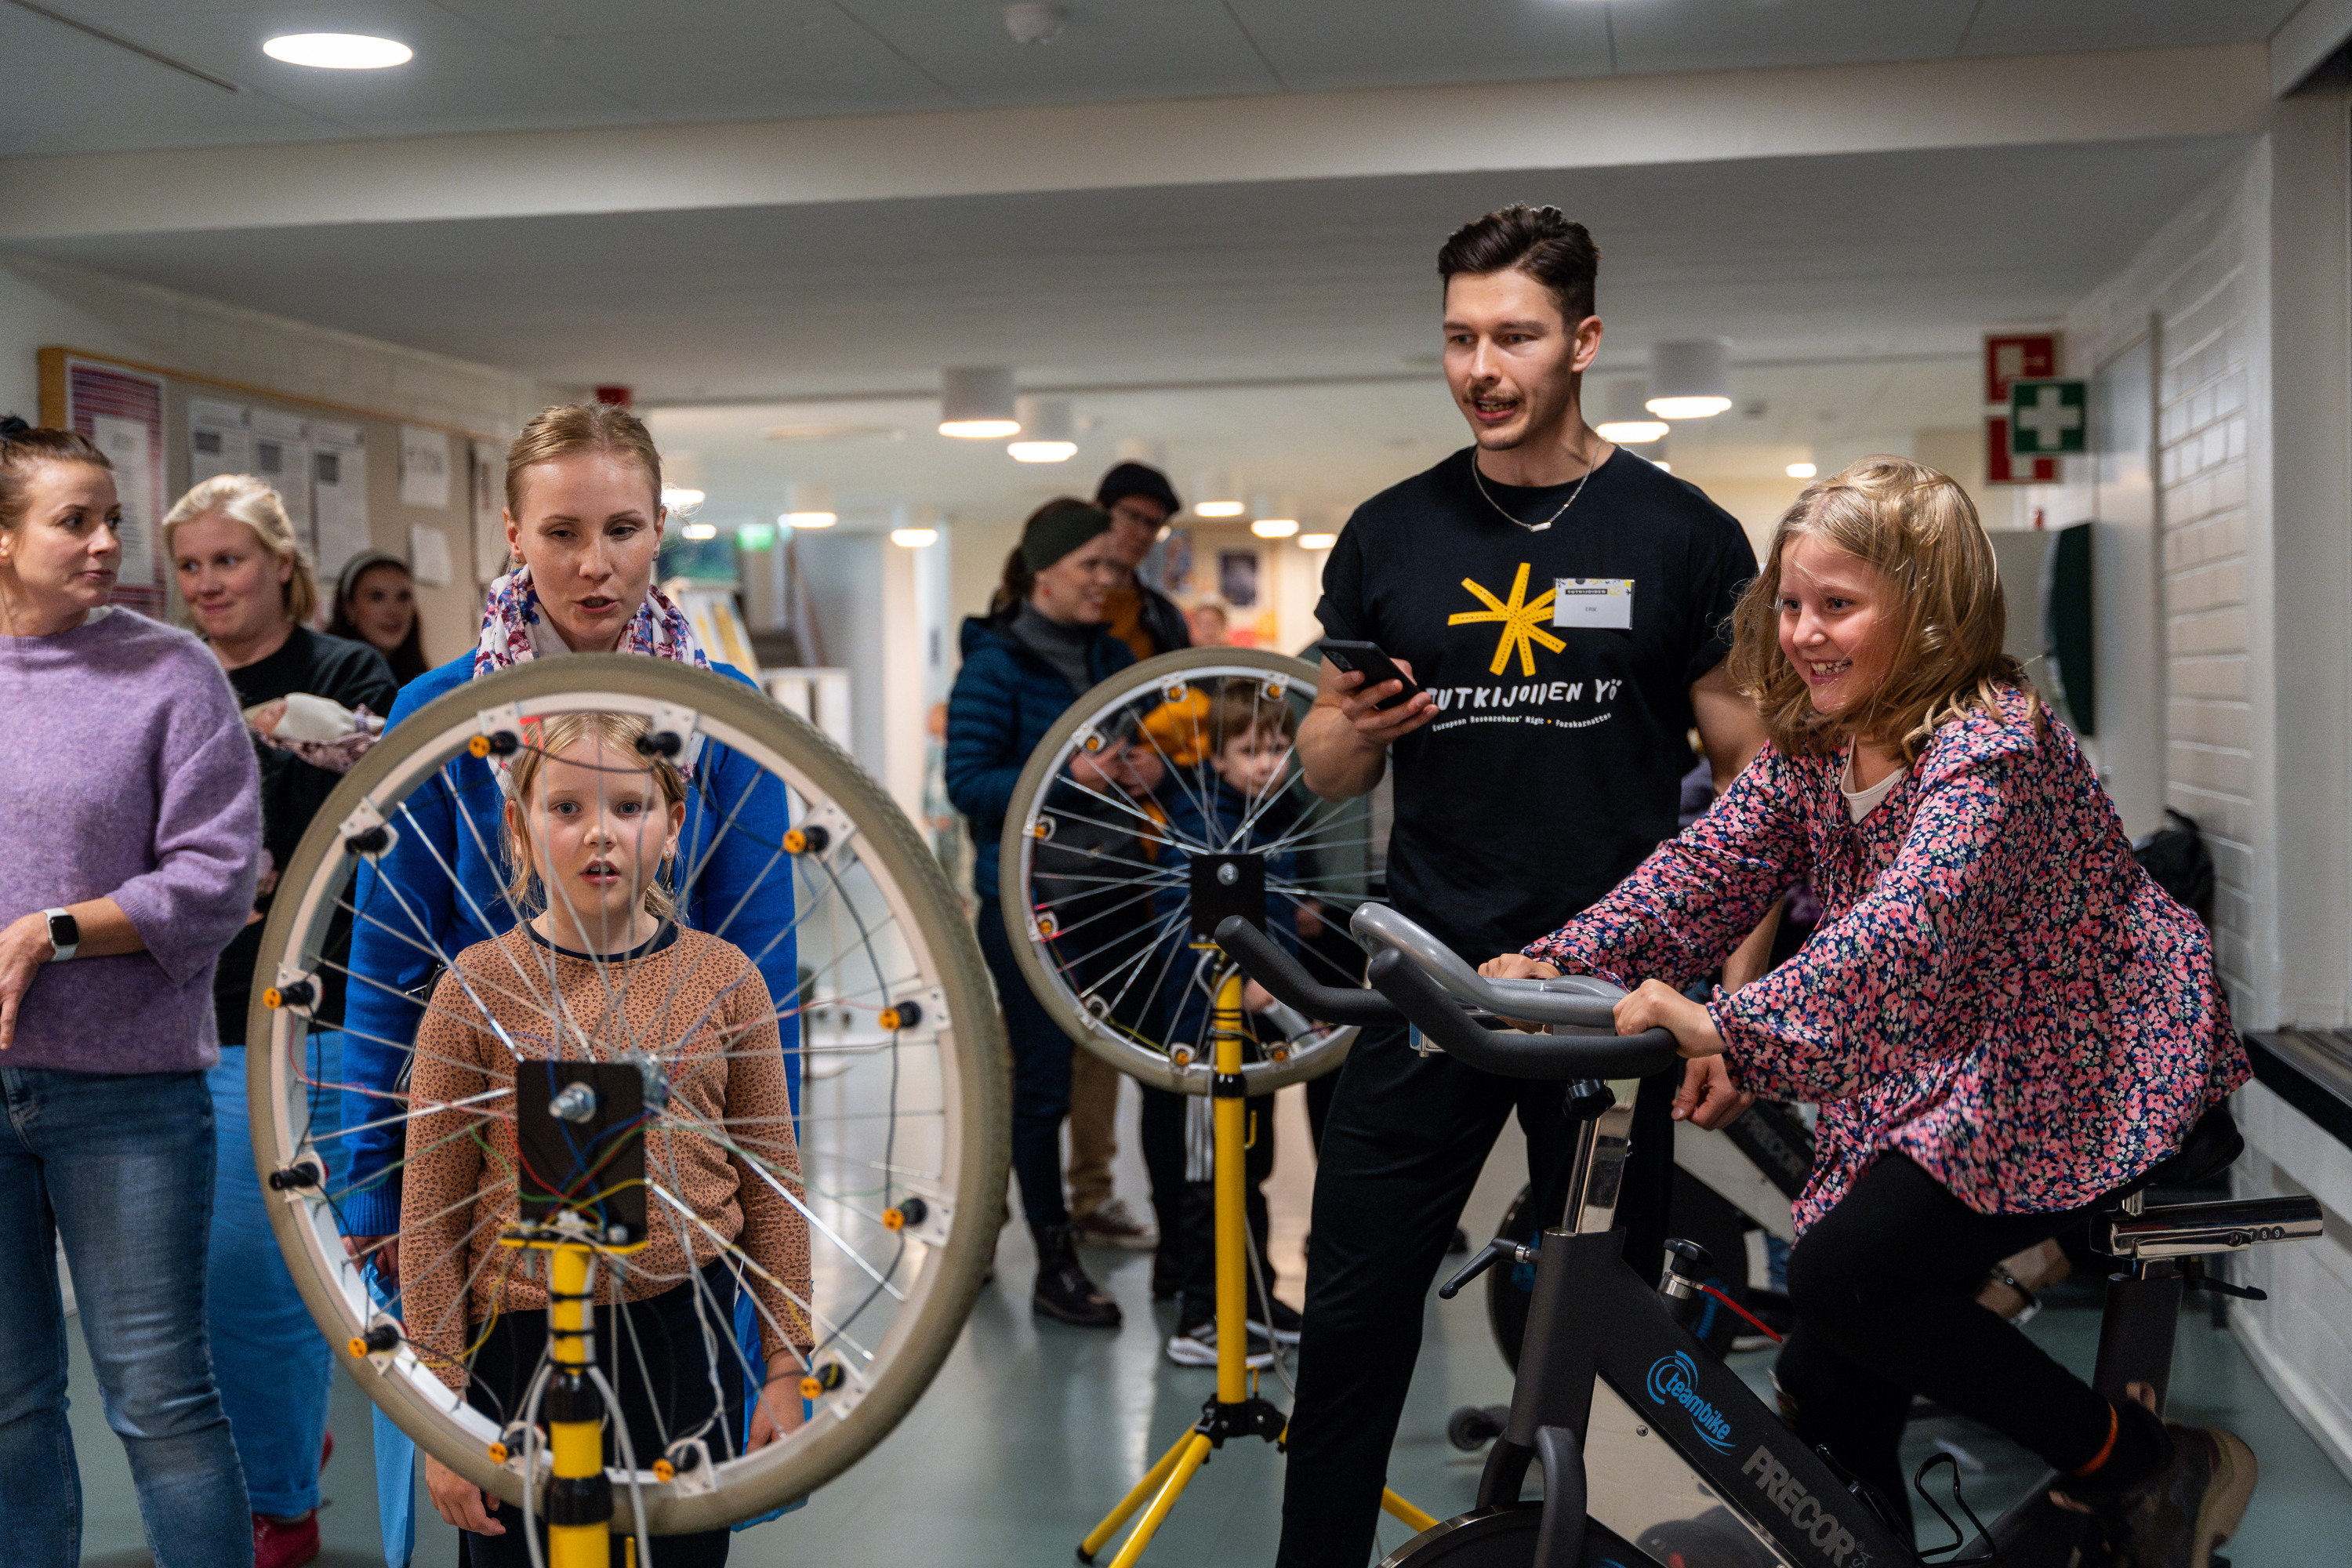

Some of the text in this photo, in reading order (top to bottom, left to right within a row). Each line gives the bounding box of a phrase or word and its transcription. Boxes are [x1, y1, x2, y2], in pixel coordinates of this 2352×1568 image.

[1432, 718, 1467, 732] European
[1525, 716, 1544, 725] Night
[1555, 713, 1612, 728] Forskarnatten
[1665, 1372, 1731, 1440] teambike
[1740, 1444, 1856, 1567] PRECOR
[1849, 1552, 1874, 1568] SA
